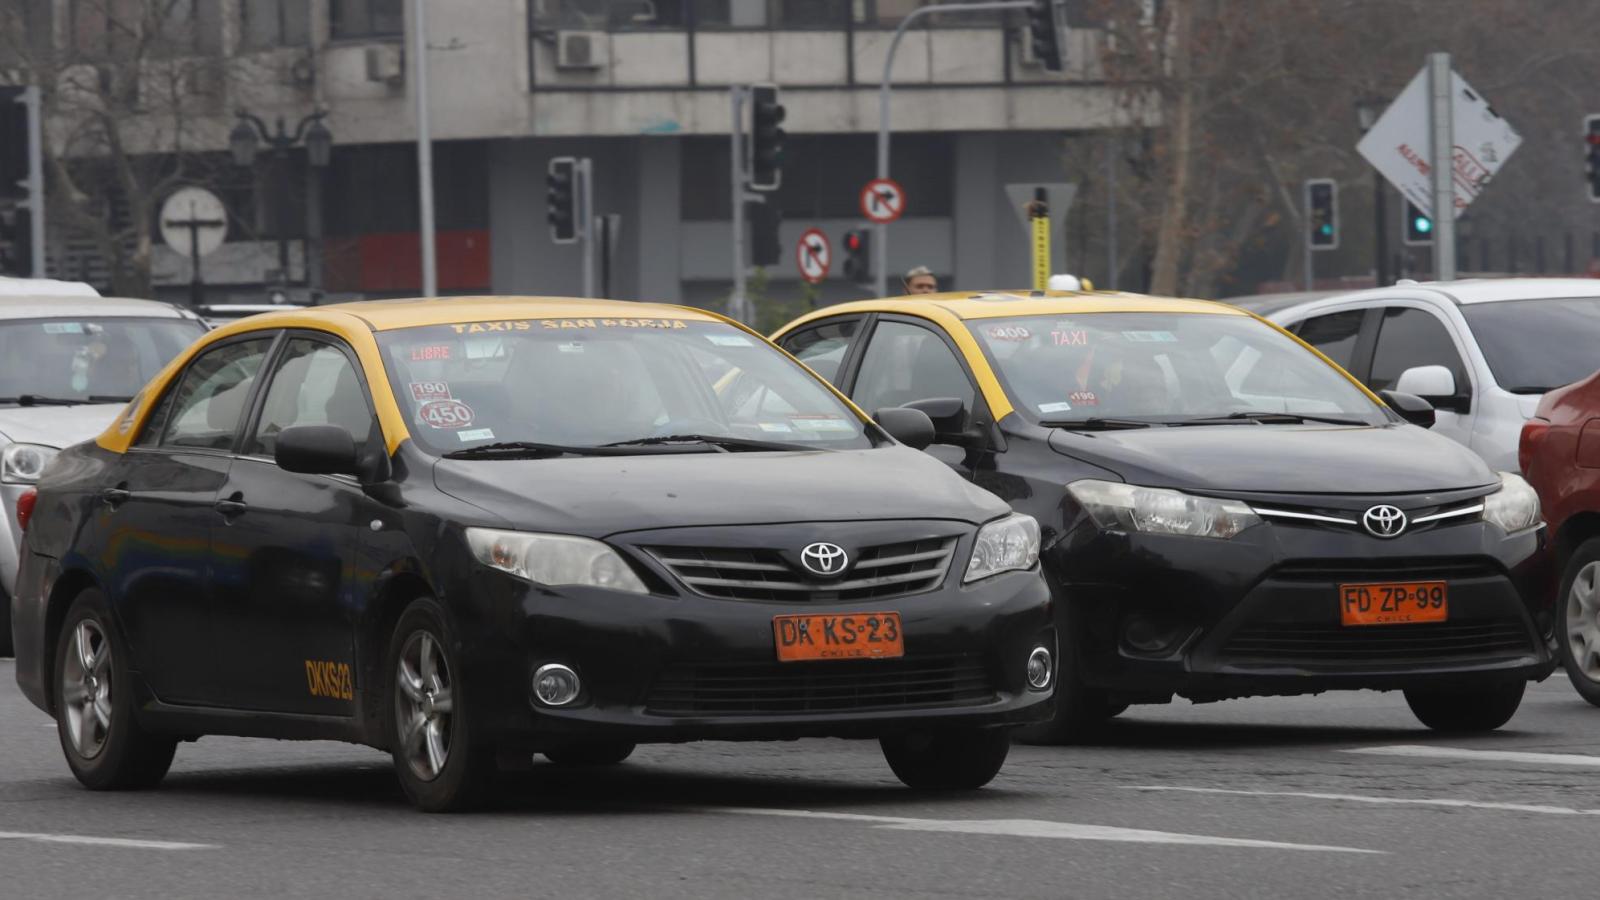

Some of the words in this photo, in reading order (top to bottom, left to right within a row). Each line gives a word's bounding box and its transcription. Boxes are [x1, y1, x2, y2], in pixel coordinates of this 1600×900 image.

[450, 321, 530, 333] TAXIS
[541, 320, 597, 329] SAN
[1051, 330, 1088, 345] TAXI
[411, 345, 449, 360] LIBRE
[429, 406, 470, 423] 450
